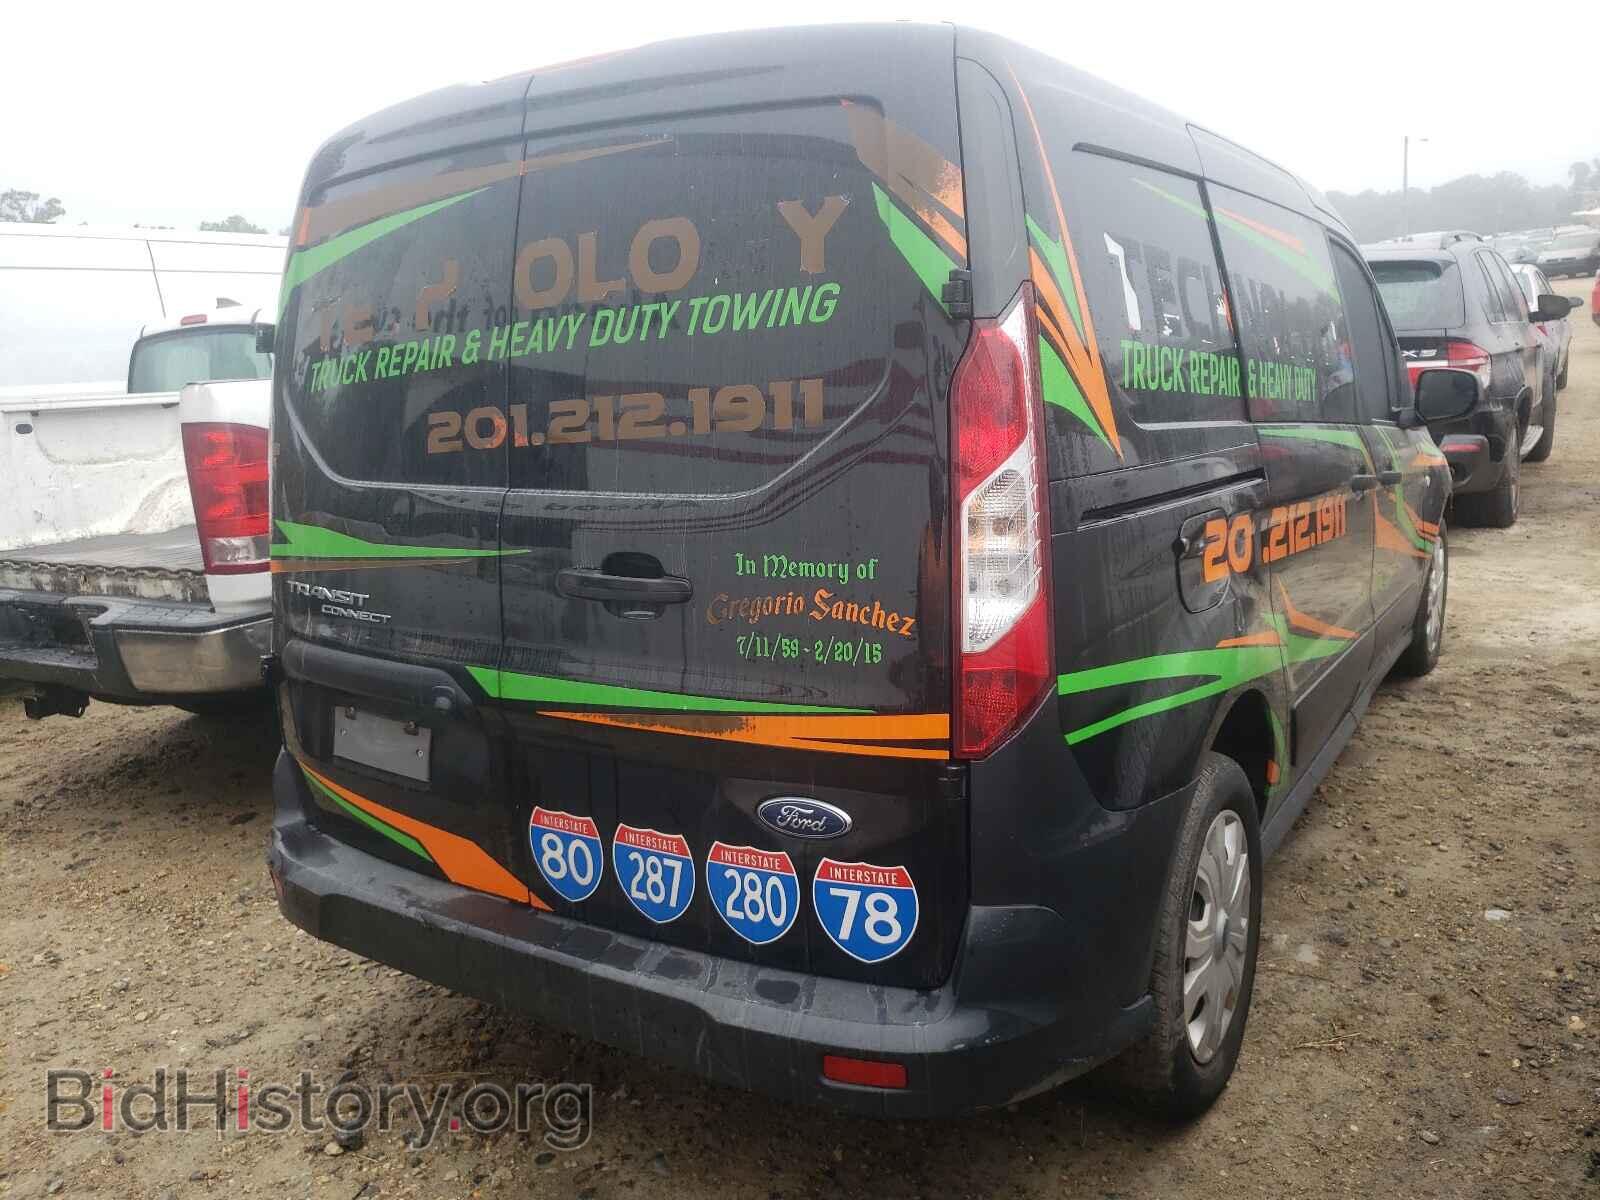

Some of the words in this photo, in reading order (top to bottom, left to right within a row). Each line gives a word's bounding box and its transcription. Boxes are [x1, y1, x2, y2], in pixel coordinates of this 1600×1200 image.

[311, 350, 371, 393] TRUCK
[375, 335, 456, 380] REPAIR
[462, 329, 481, 365] &
[487, 312, 585, 361] HEAVY
[589, 300, 681, 348] DUTY
[687, 282, 841, 337] TOWING
[1119, 339, 1185, 392] TRUCK
[1189, 350, 1241, 397] REPAIR
[1247, 357, 1257, 399] &
[1259, 359, 1293, 401] HEAVY
[1295, 365, 1317, 402] DUTY
[427, 378, 824, 455] 201.212.1911
[1203, 492, 1347, 583] 20.212.1911
[287, 580, 370, 607] TRANSIT
[735, 552, 756, 576] In
[763, 554, 849, 585] Memory
[856, 558, 879, 580] of
[321, 604, 392, 624] CONNECT
[809, 587, 917, 637] Sanchez
[540, 814, 588, 834] INTERSTATE
[624, 831, 678, 854] INTERSTATE
[541, 833, 593, 887] 80
[628, 851, 683, 908] 287
[720, 849, 781, 871] INTERSTATE
[829, 866, 898, 886] INTERSTATE
[725, 868, 787, 927] 280
[829, 887, 901, 945] 78
